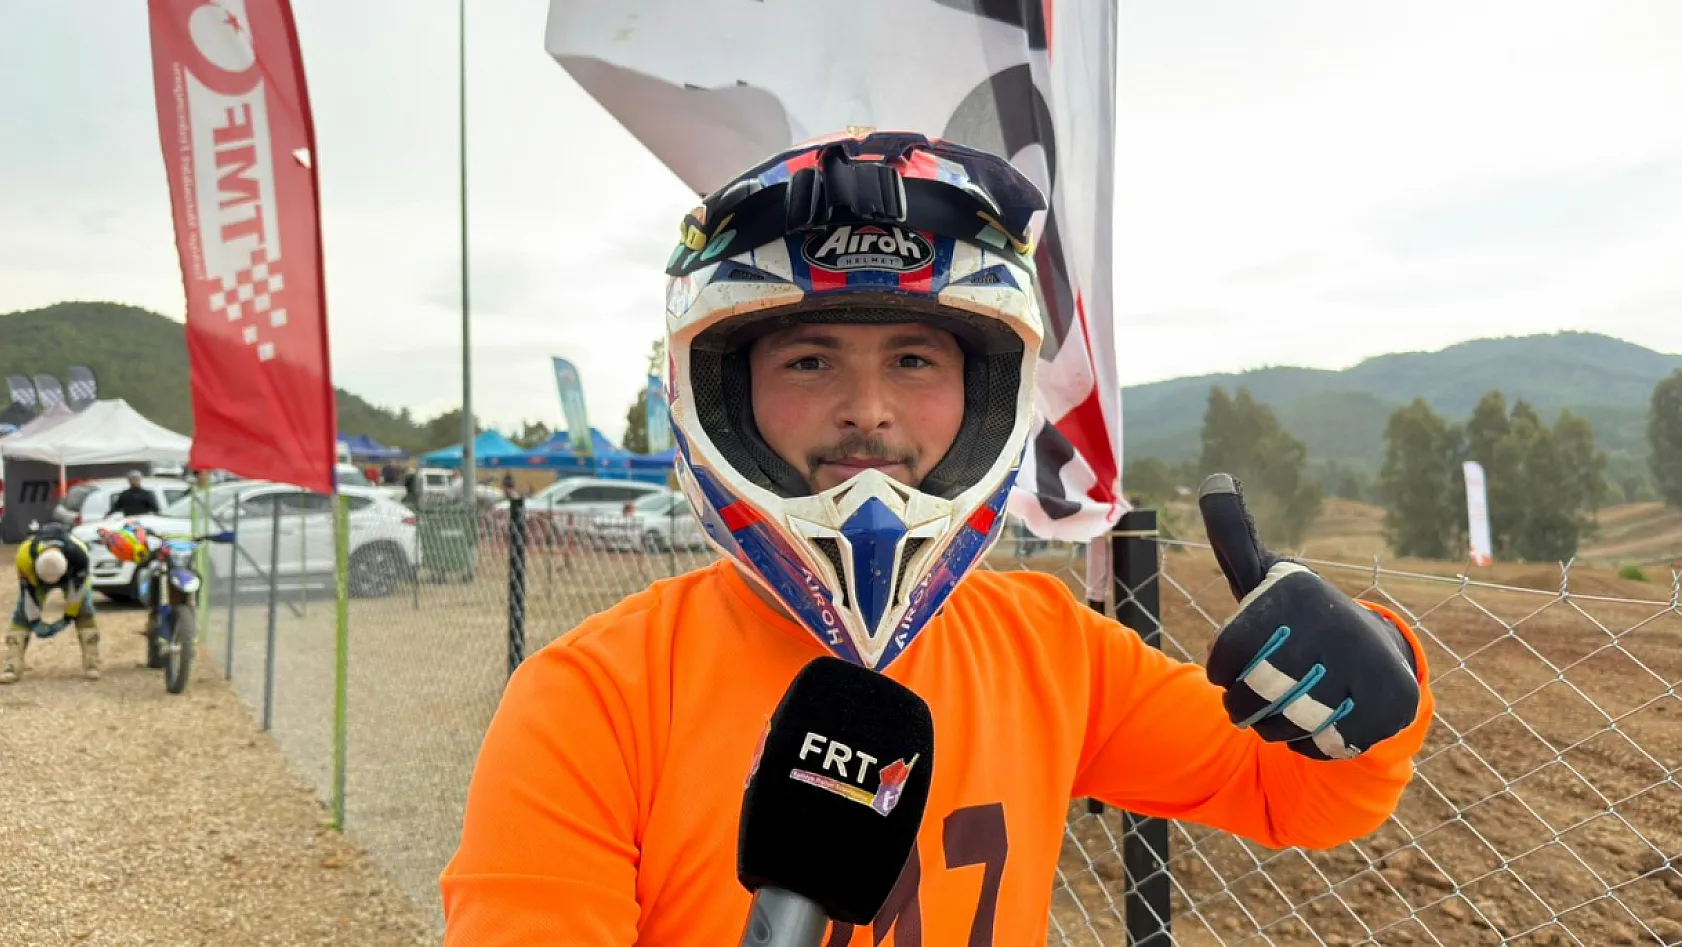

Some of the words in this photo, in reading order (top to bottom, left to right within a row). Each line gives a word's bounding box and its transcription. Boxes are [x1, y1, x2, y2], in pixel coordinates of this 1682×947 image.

[814, 225, 921, 259] Airoh
[846, 257, 895, 266] HELMET
[801, 566, 844, 646] AIROH
[799, 731, 878, 784] FRT
